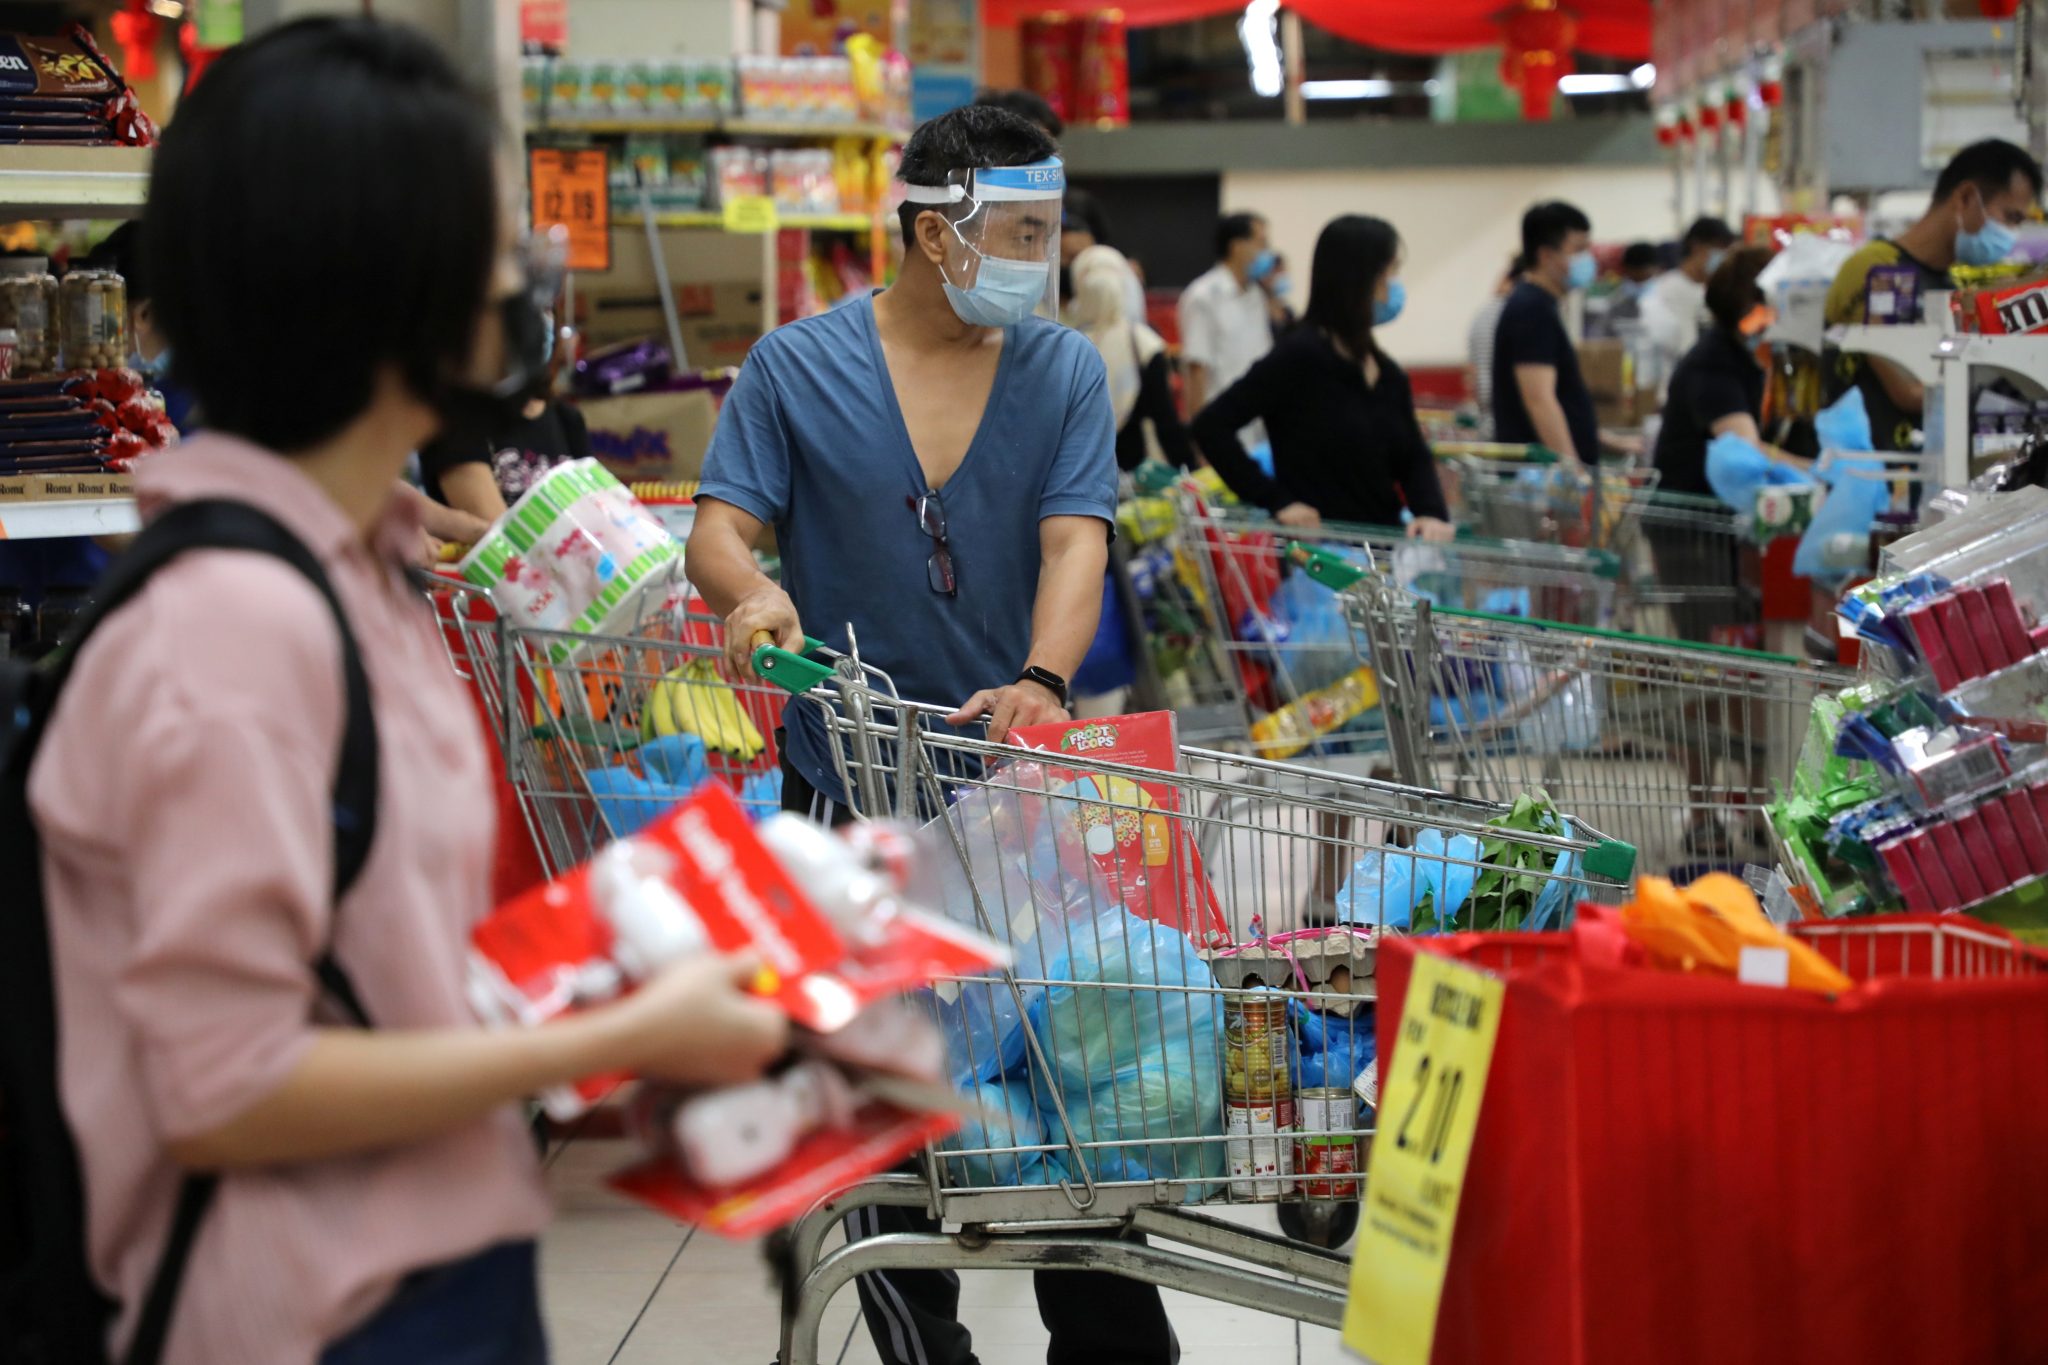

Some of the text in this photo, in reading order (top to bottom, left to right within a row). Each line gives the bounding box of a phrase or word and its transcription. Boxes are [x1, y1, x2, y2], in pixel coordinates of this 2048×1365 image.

[46, 482, 72, 495] Roma
[78, 482, 104, 495] Roma
[1069, 726, 1110, 746] FROOT
[1076, 736, 1115, 752] LOOPS
